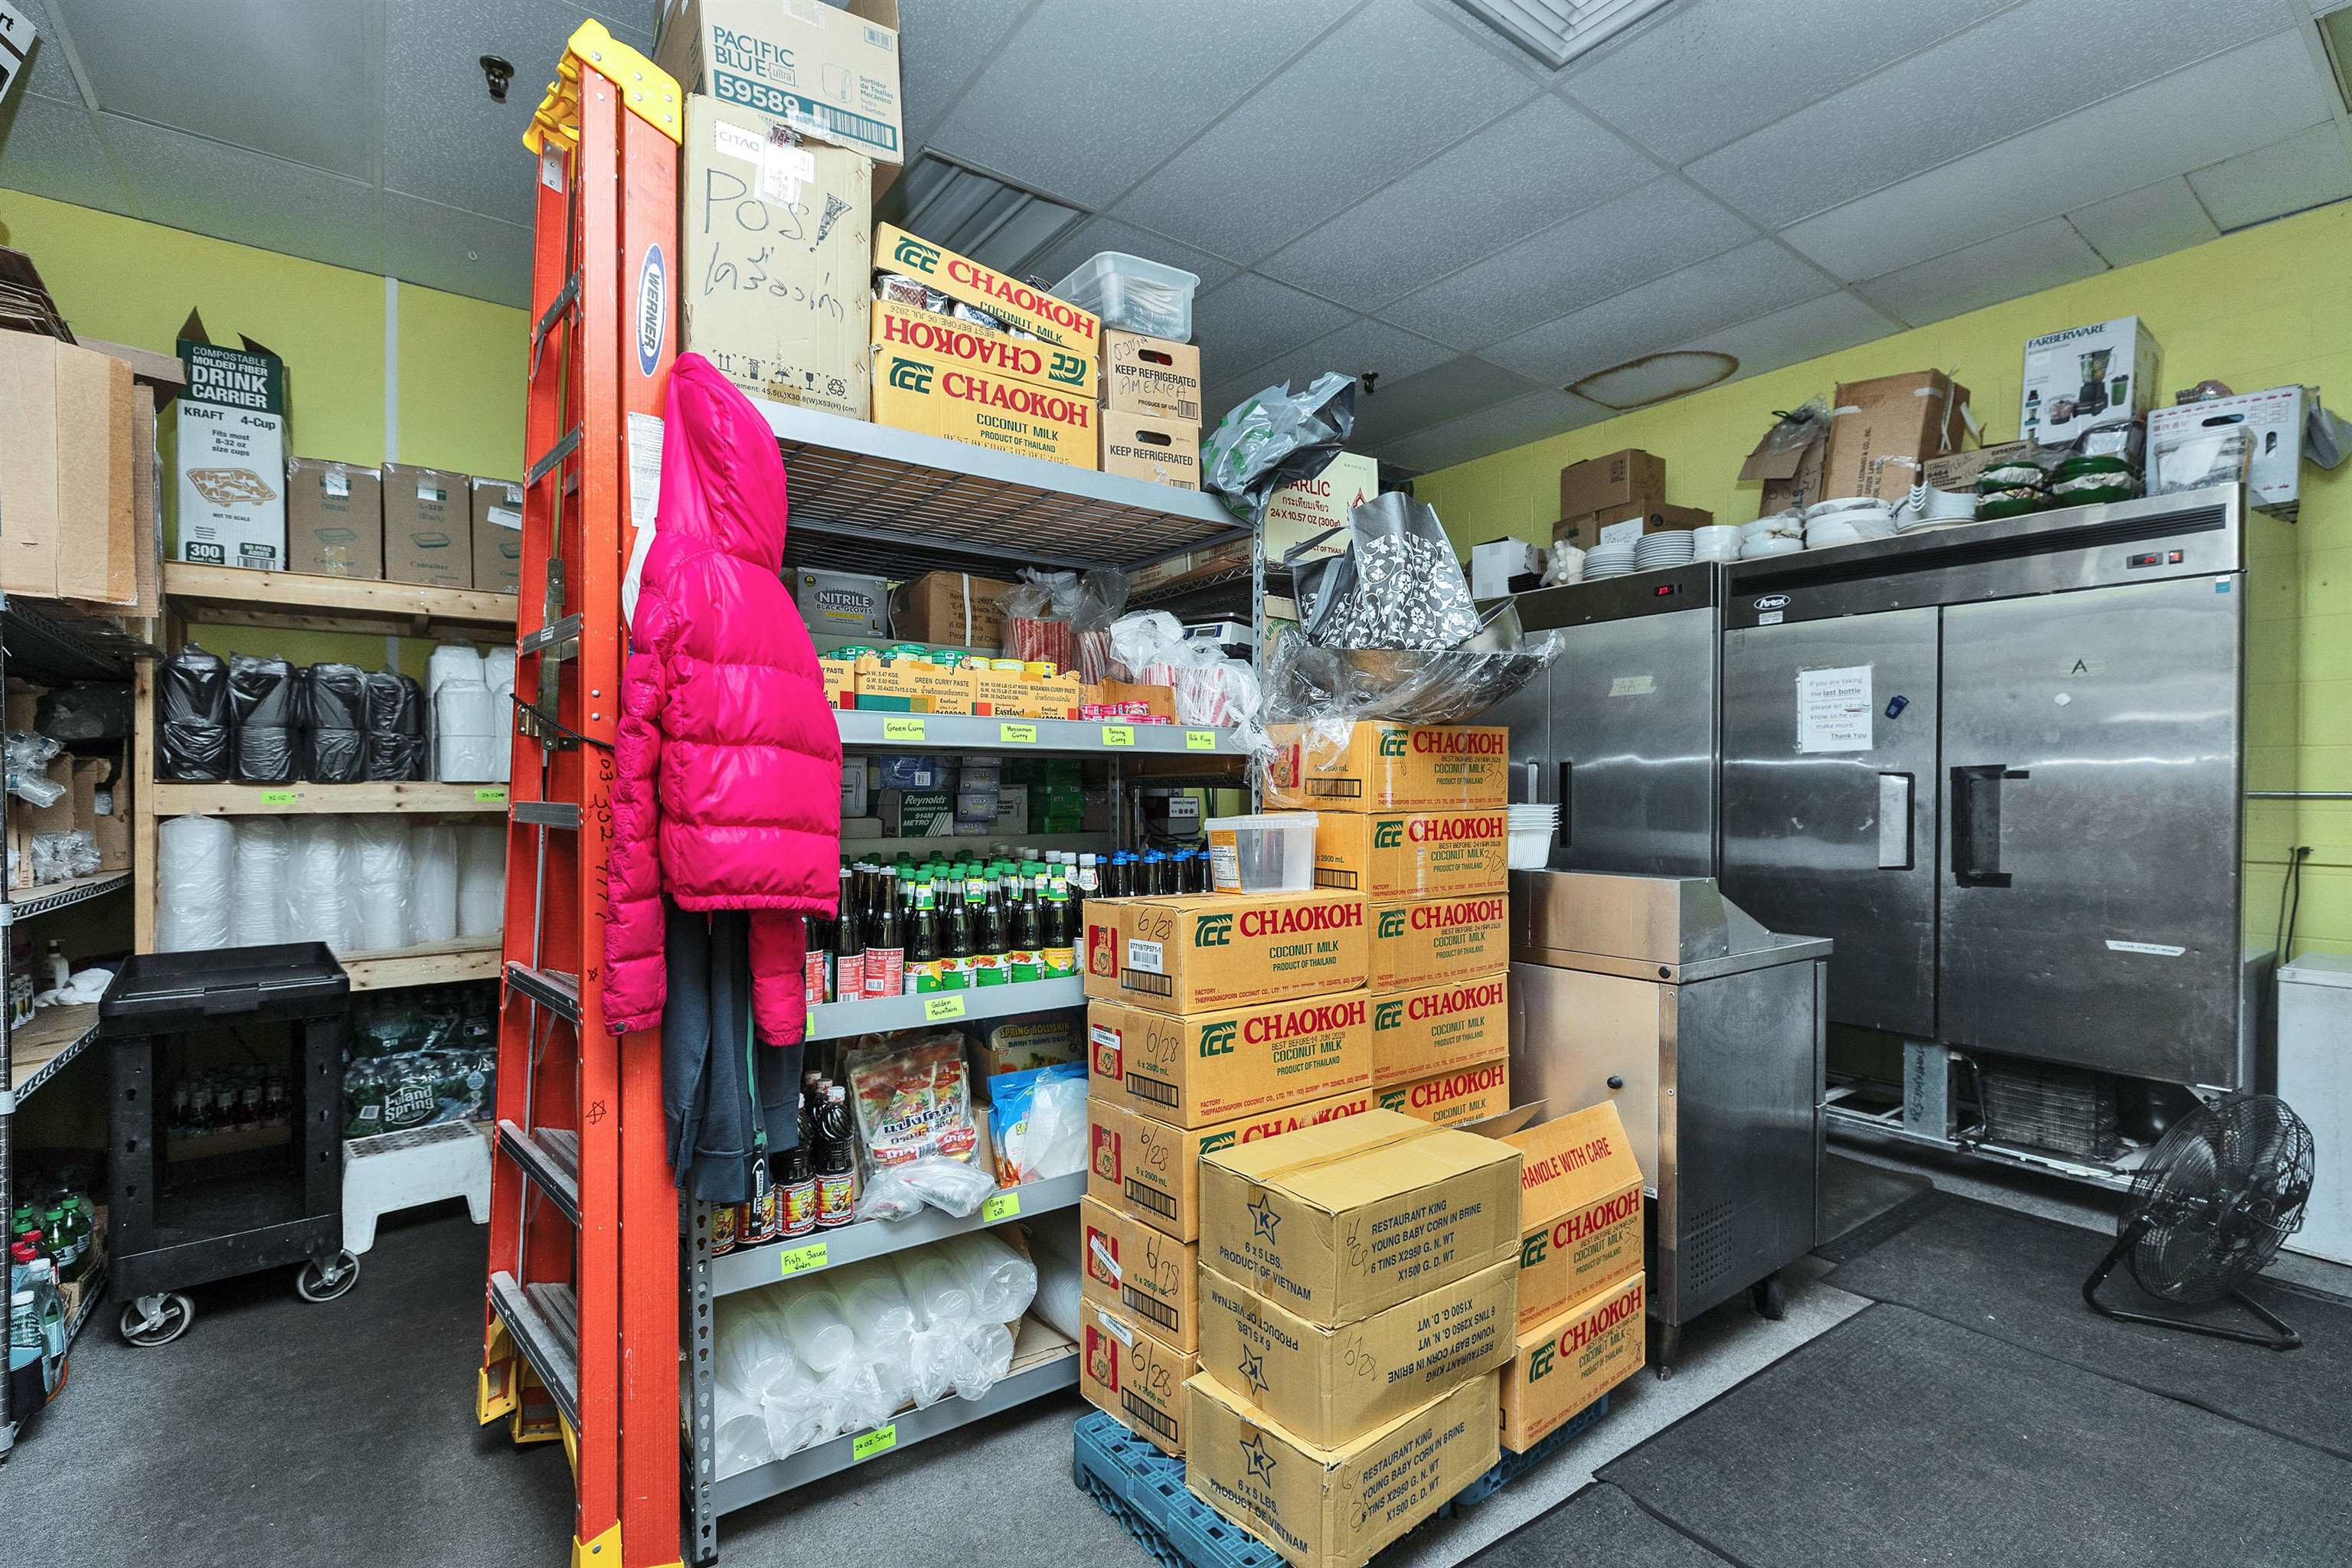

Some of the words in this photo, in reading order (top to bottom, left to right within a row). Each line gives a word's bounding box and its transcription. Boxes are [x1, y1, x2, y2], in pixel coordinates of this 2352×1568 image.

[714, 25, 795, 67] PACIFIC
[714, 44, 766, 77] BLUE
[773, 66, 792, 82] ultra
[718, 74, 799, 113] 59589
[644, 272, 660, 350] WERNER
[947, 260, 1095, 339] CHAOKOH
[980, 301, 1032, 332] COCONUT
[1037, 323, 1063, 344] MILK
[884, 314, 1042, 375] CHAOKOH
[2028, 323, 2106, 348] FARBERWARE
[193, 347, 266, 367] COMPOSTABLE
[193, 356, 236, 370] MOLDED
[239, 364, 268, 377] FIBER
[192, 365, 268, 394] DRINK
[1115, 364, 1137, 377] KEEP
[1138, 368, 1197, 388] REFRIGERATED
[192, 384, 267, 409] CARRIER
[942, 372, 1089, 428] CHAOKOH
[1138, 399, 1161, 409] PRODUCE
[185, 407, 224, 420] KRAFT
[240, 416, 276, 430] 4-Cup
[976, 413, 1029, 434] COCONUT
[1033, 426, 1060, 441] MILK
[230, 433, 250, 441] most
[980, 430, 1011, 445] PRODUCT
[1014, 436, 1023, 446] OF
[1024, 437, 1056, 453] THAILAND
[1109, 445, 1132, 458] KEEP
[1134, 448, 1194, 466] REFRIGERATED
[1285, 479, 1331, 497] ARLIC
[1271, 508, 1281, 517] 24
[1289, 511, 1305, 521] 10.57
[1308, 515, 1317, 524] OZ
[190, 544, 220, 558] 300
[816, 603, 843, 612] BLACK
[844, 606, 873, 614] GLOVES
[819, 592, 870, 606] NITRILE
[871, 619, 879, 630] L
[2071, 658, 2088, 674] A
[887, 720, 906, 732] Green
[908, 720, 925, 733] Curry
[1414, 730, 1504, 753] CHAOKOH
[1434, 764, 1467, 773] COCONUT
[1469, 764, 1485, 773] MILK
[905, 795, 946, 805] Reynolds
[1408, 817, 1503, 842] CHAOKOH
[1240, 903, 1363, 938] CHAOKOH
[1412, 900, 1503, 929] CHAOKOH
[1272, 960, 1299, 972] PRODUCT
[1301, 959, 1308, 968] OF
[1309, 956, 1337, 966] THAILAND
[931, 999, 951, 1008] Golden
[1195, 988, 1215, 997] FACTORY
[1409, 983, 1504, 1020] CHAOKOH
[931, 1005, 957, 1016] Mountain
[1000, 1026, 1030, 1038] SPRING
[1244, 1001, 1365, 1045] CHAOKOH
[385, 1097, 435, 1122] Spring
[1200, 1099, 1221, 1108] FACTORY
[1245, 1099, 1265, 1108] COCONUT
[1522, 1161, 1560, 1190] HANDLE
[1560, 1148, 1583, 1174] WITH
[1586, 1136, 1612, 1161] CARE
[1259, 1212, 1270, 1228] K
[1371, 1209, 1426, 1235] RESTAURANT
[1428, 1200, 1447, 1217] KING
[1372, 1236, 1397, 1253] YOUNG
[1400, 1228, 1424, 1245] BABY
[1426, 1219, 1449, 1236] CORN
[1451, 1215, 1458, 1225] IN
[1459, 1202, 1481, 1221] BRINE
[784, 1253, 802, 1267] Fish
[806, 1249, 827, 1262] Sauce
[1246, 1243, 1250, 1253] 6
[1258, 1250, 1263, 1259] 5
[1265, 1252, 1282, 1269] LBS.
[1370, 1263, 1376, 1275] 6
[1377, 1255, 1395, 1272] TINS
[1396, 1246, 1422, 1265] X2950
[1442, 1232, 1455, 1248] WT
[1220, 1246, 1257, 1271] PRODUCT
[1260, 1266, 1270, 1279] OF
[1272, 1272, 1312, 1301] VIETNAM
[1398, 1262, 1422, 1282] X1500
[1442, 1250, 1455, 1266] WT
[1212, 1292, 1245, 1318] VIETNAM
[1246, 1312, 1257, 1325] OF
[1259, 1318, 1298, 1351] PRODUCT
[1445, 1340, 1494, 1371] RESTAURANT
[1426, 1364, 1446, 1383] KING
[876, 1432, 893, 1445] Soup
[1363, 1475, 1390, 1501] YOUNG
[1390, 1460, 1413, 1481] BABY
[1415, 1446, 1434, 1465] CORN
[1443, 1422, 1465, 1443] BRINE
